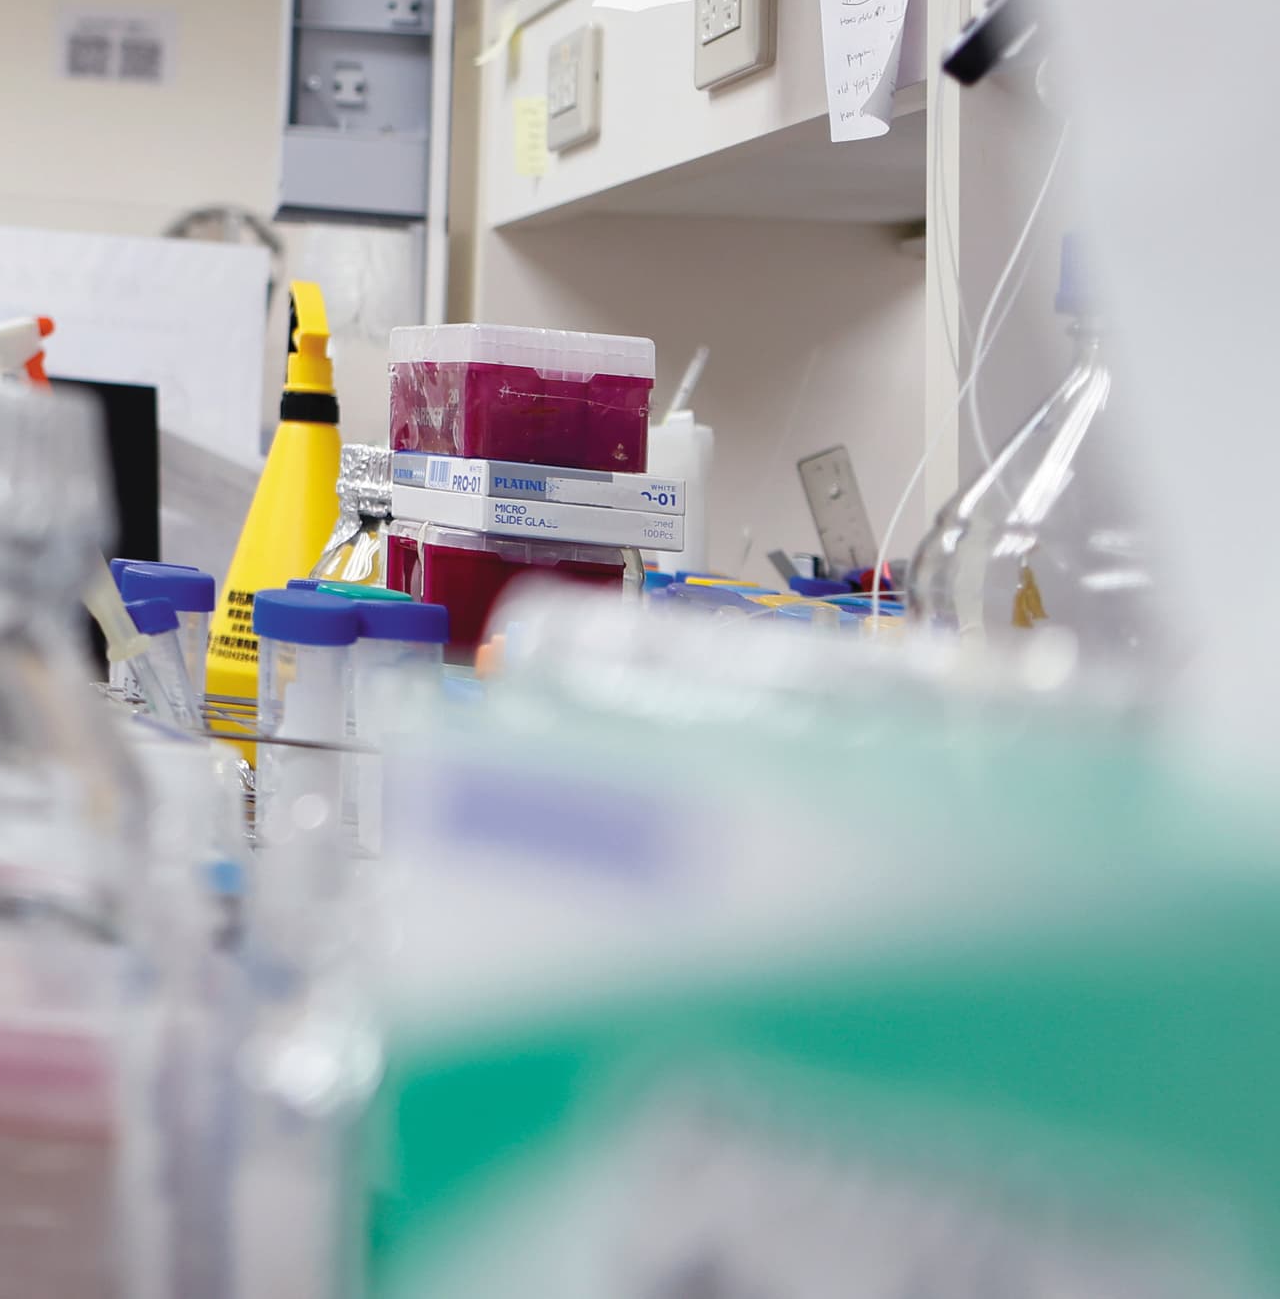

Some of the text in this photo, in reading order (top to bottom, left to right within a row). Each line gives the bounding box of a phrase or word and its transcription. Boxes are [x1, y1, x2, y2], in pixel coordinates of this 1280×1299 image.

[452, 474, 482, 493] PRO-01
[494, 476, 558, 492] PLATINU
[650, 484, 678, 493] WHITE
[495, 503, 527, 515] MICRO
[495, 514, 559, 529] SLIDE GLA
